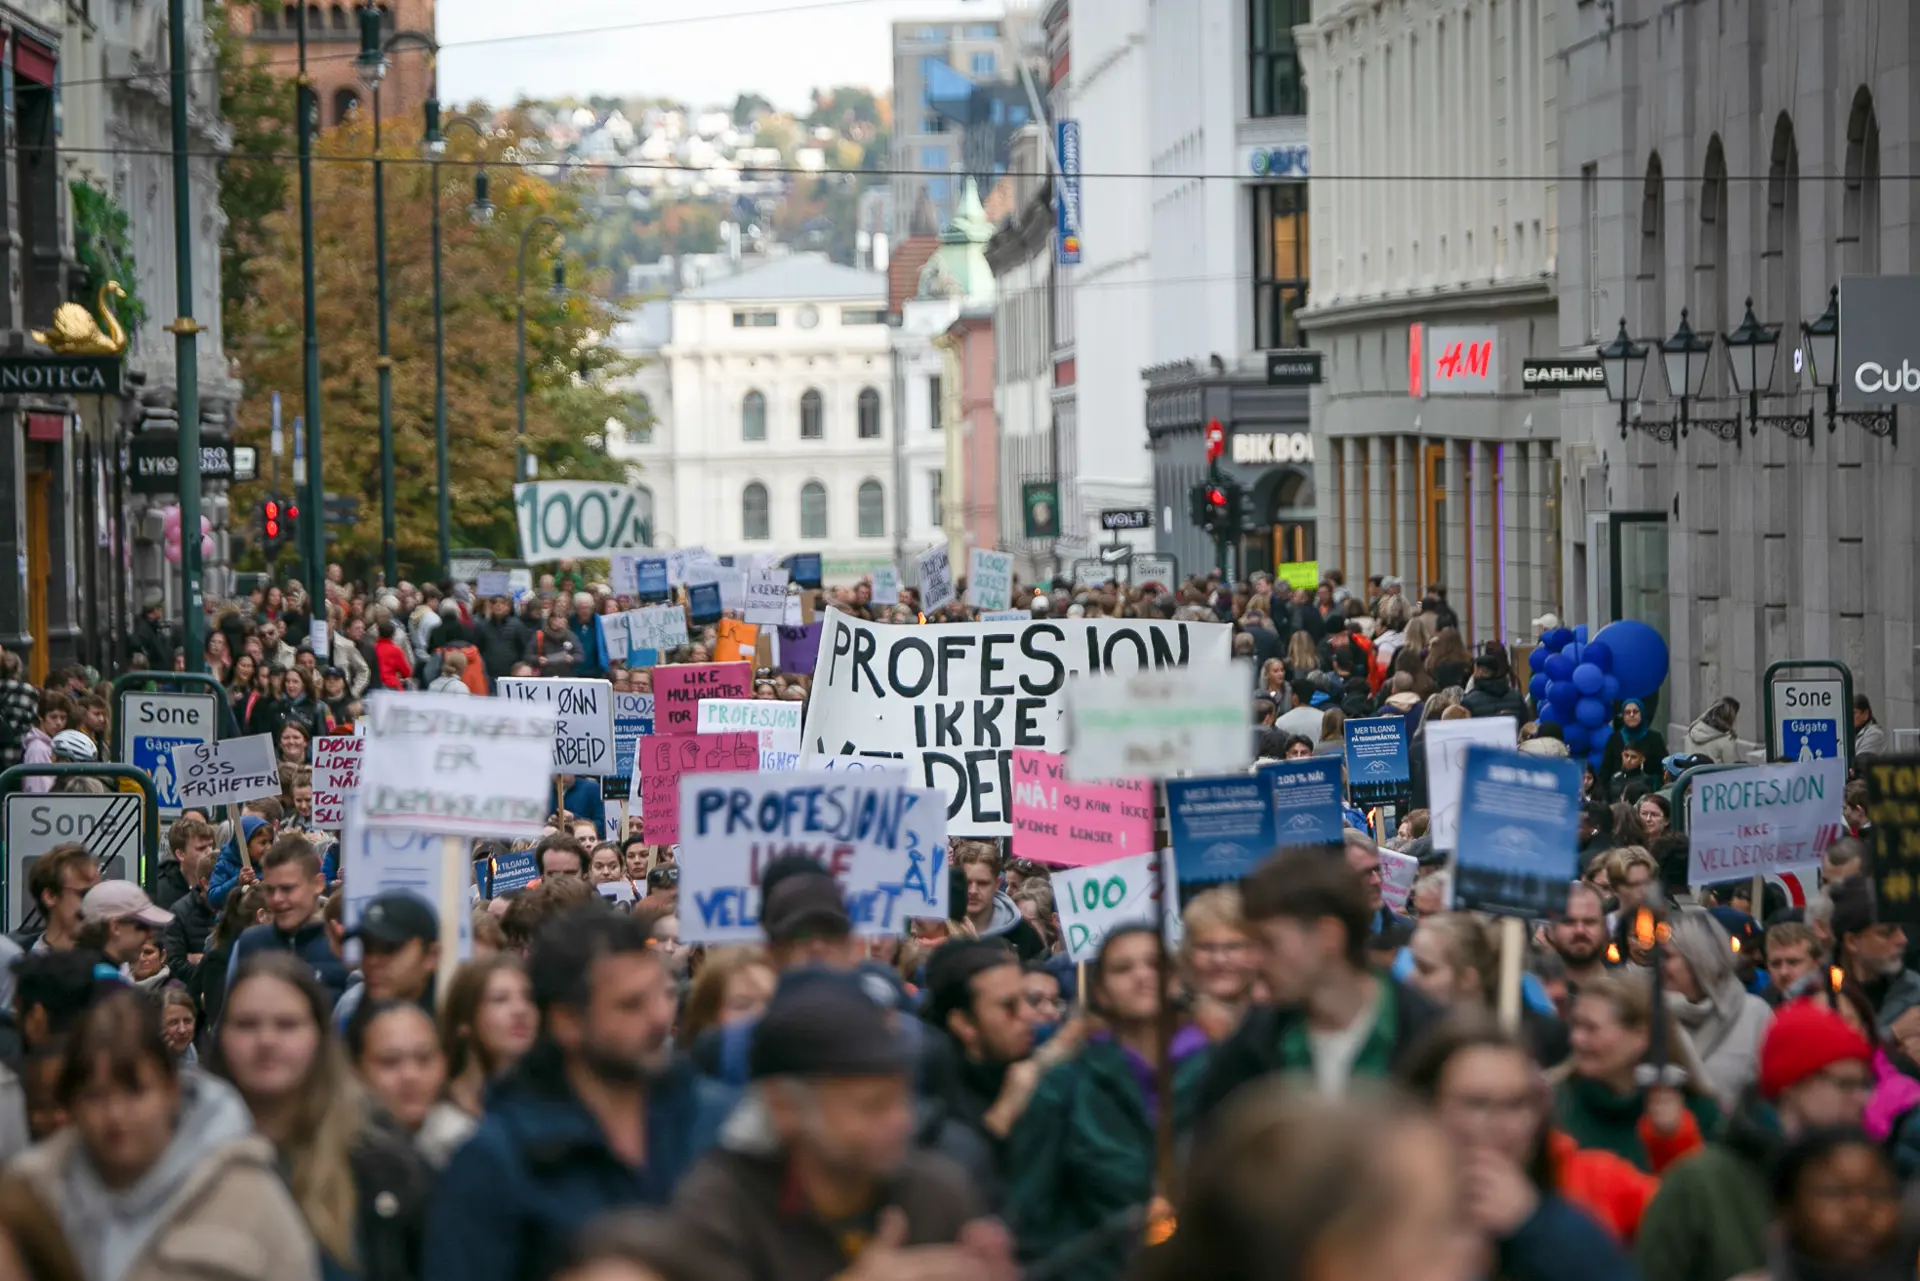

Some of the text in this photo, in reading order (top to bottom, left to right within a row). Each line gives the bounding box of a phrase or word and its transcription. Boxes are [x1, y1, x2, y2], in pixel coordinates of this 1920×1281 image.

[1855, 358, 1920, 392] Cub
[684, 670, 720, 684] LIKE
[667, 684, 743, 702] MULIGHETER
[1785, 687, 1832, 707] Sone
[140, 702, 199, 724] Sone
[668, 710, 691, 723] FOR
[708, 704, 798, 728] PROFESJON
[914, 697, 1046, 747] IKKE
[1354, 724, 1396, 735] MER TILGANG
[1791, 721, 1829, 733] Gågate
[145, 737, 194, 751] Gågat
[318, 738, 364, 753] DØVE
[188, 761, 235, 777] OSS
[313, 791, 344, 805] TOL
[1015, 779, 1057, 812] NÅ!
[1701, 774, 1825, 813] PROFESJON
[30, 806, 118, 836] Sone
[314, 808, 344, 823] SLU
[1698, 842, 1807, 871] VELDEDIGHET
[1067, 874, 1127, 914] 100
